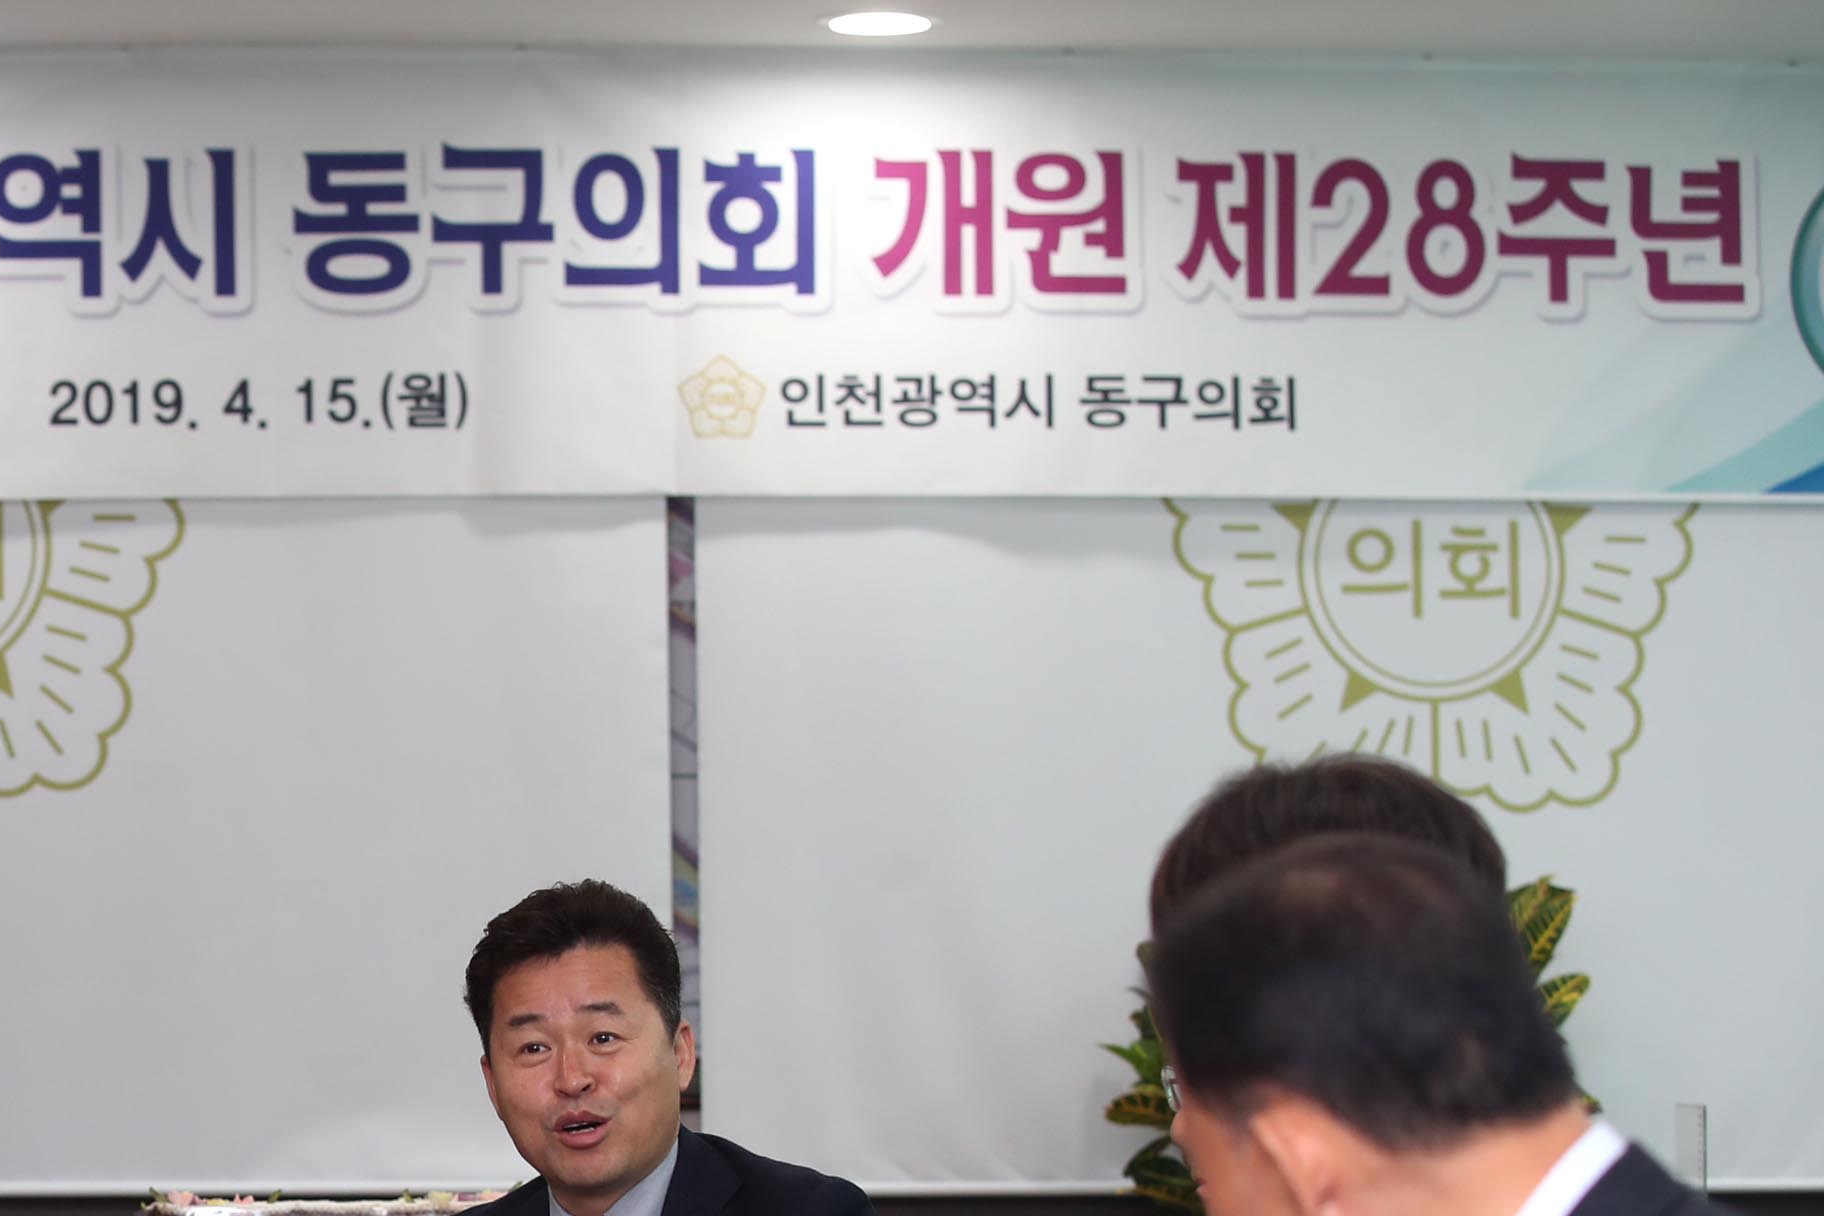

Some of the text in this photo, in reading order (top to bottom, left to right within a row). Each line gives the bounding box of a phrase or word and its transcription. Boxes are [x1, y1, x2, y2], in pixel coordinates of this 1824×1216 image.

[291, 145, 817, 296] 동구의회
[872, 148, 1129, 297] 개원
[1176, 150, 1747, 304] 제28주년
[49, 379, 197, 430] 2019.
[222, 378, 267, 430] 4.
[780, 374, 1298, 432] 인천광역시 동구의회
[1341, 518, 1521, 619] 의회
